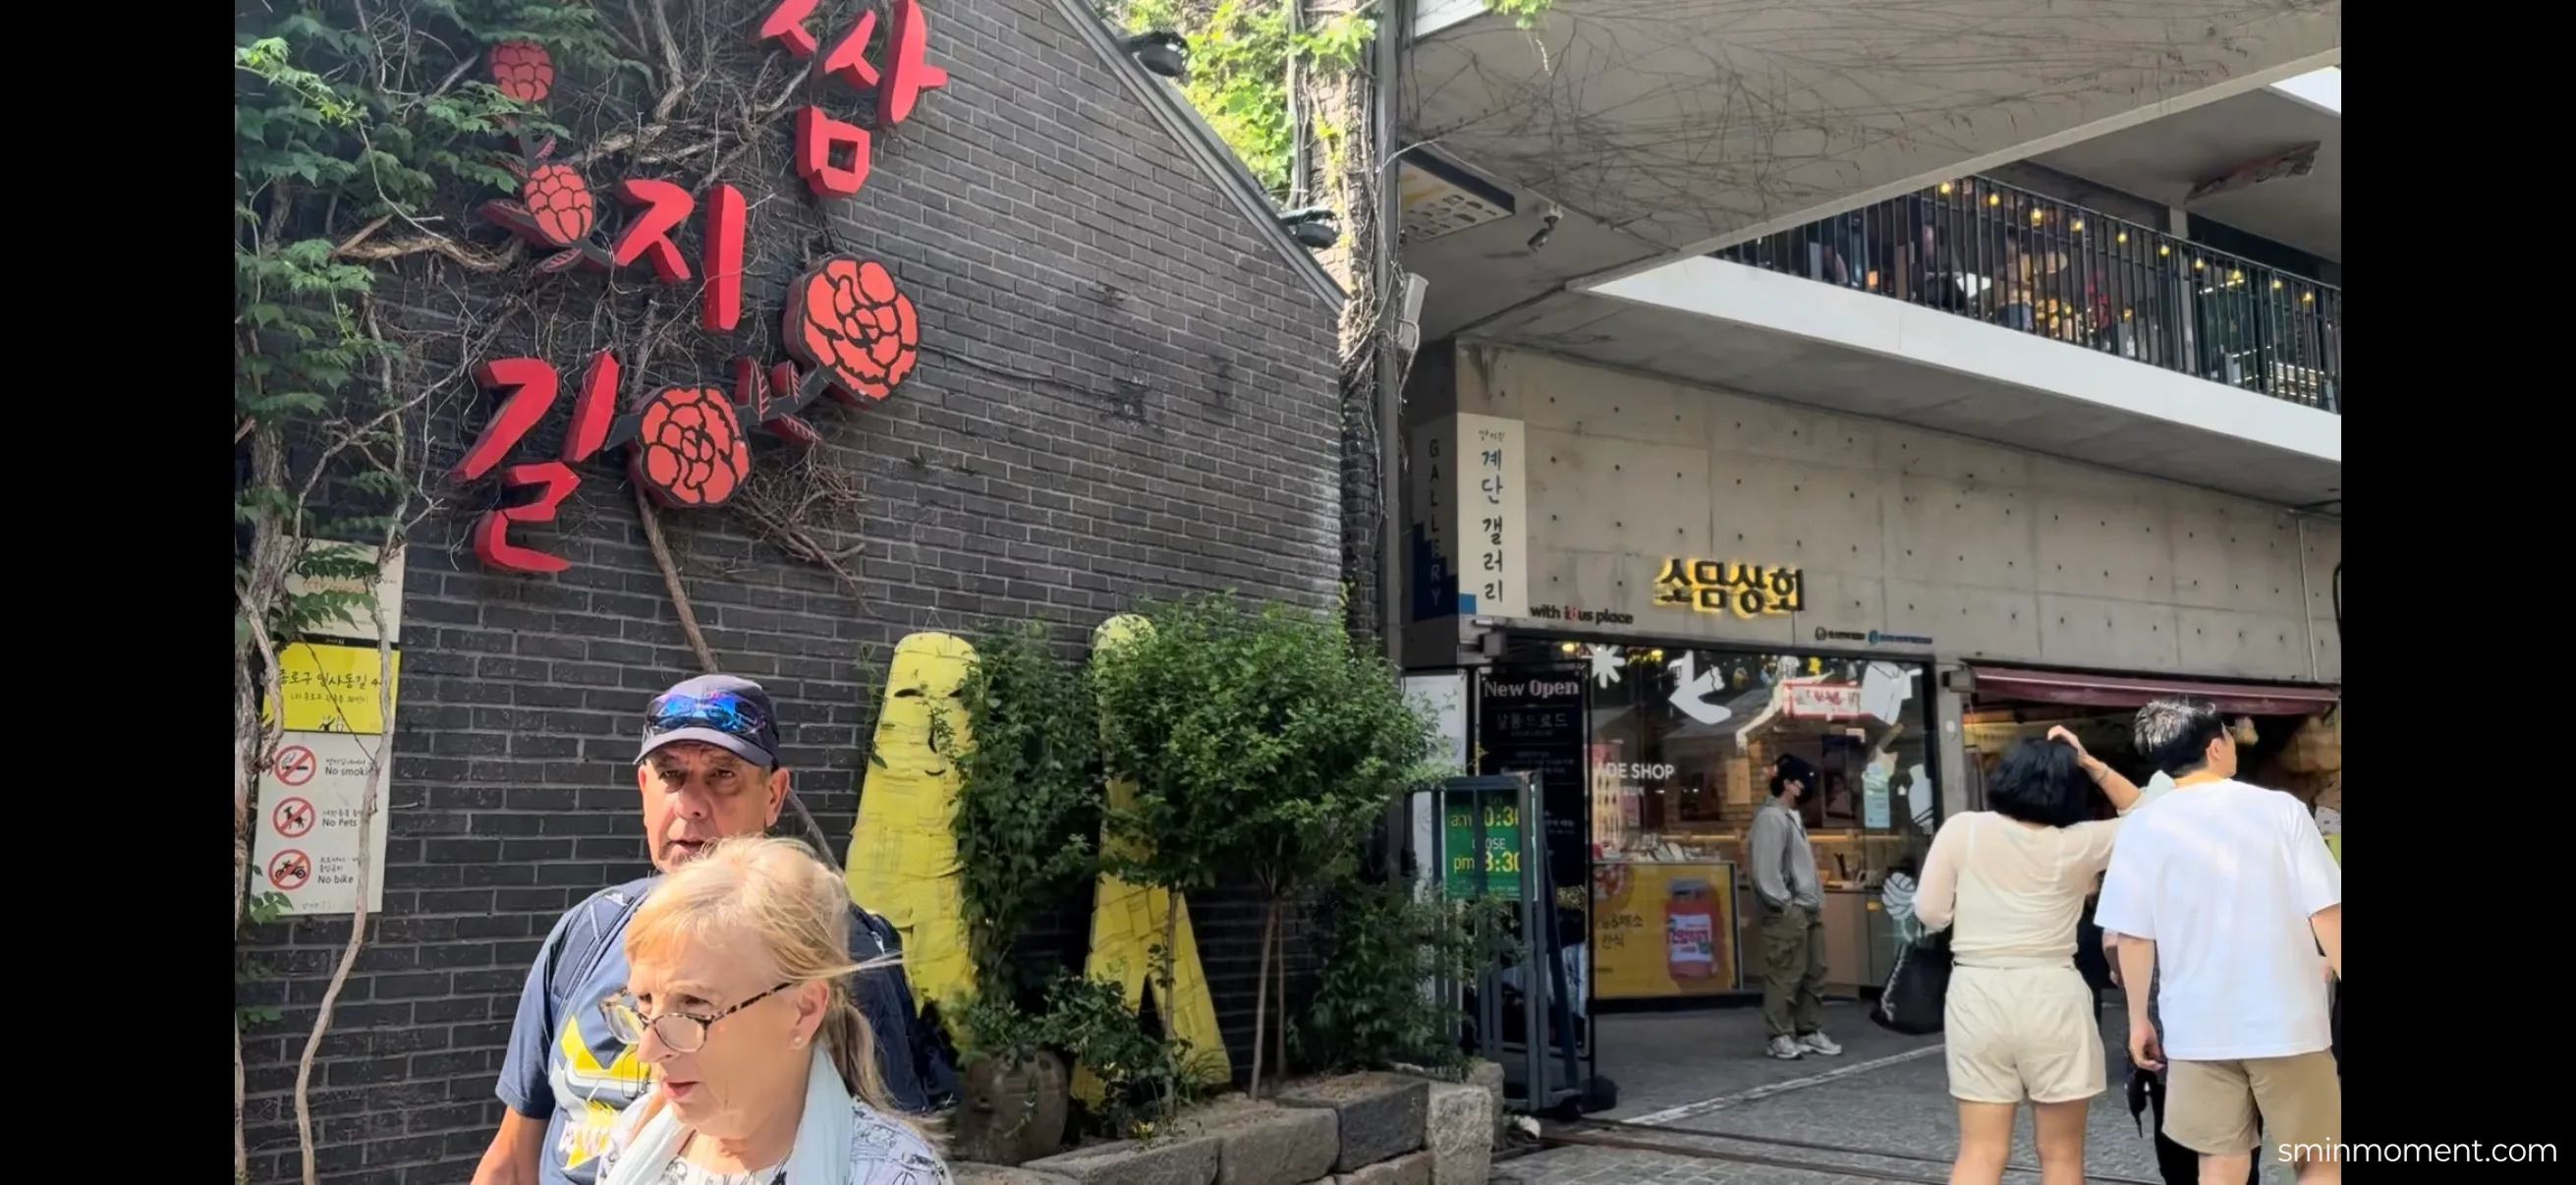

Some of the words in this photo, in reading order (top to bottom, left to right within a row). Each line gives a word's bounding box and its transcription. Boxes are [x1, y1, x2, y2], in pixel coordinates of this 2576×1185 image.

[1482, 449, 1503, 504] 계단
[1428, 439, 1441, 606] GALLERY
[1483, 516, 1503, 602] 갤러리
[1530, 603, 1560, 619] with
[1596, 608, 1634, 625] place
[1484, 681, 1525, 698] New
[1529, 679, 1579, 699] Open
[324, 766, 338, 775] No
[1631, 762, 1674, 779] SHOP
[322, 818, 336, 827] No
[338, 818, 358, 827] Pets
[1450, 815, 1473, 826] am
[1454, 857, 1475, 875] pm
[317, 875, 332, 884] No
[334, 875, 354, 884] bike
